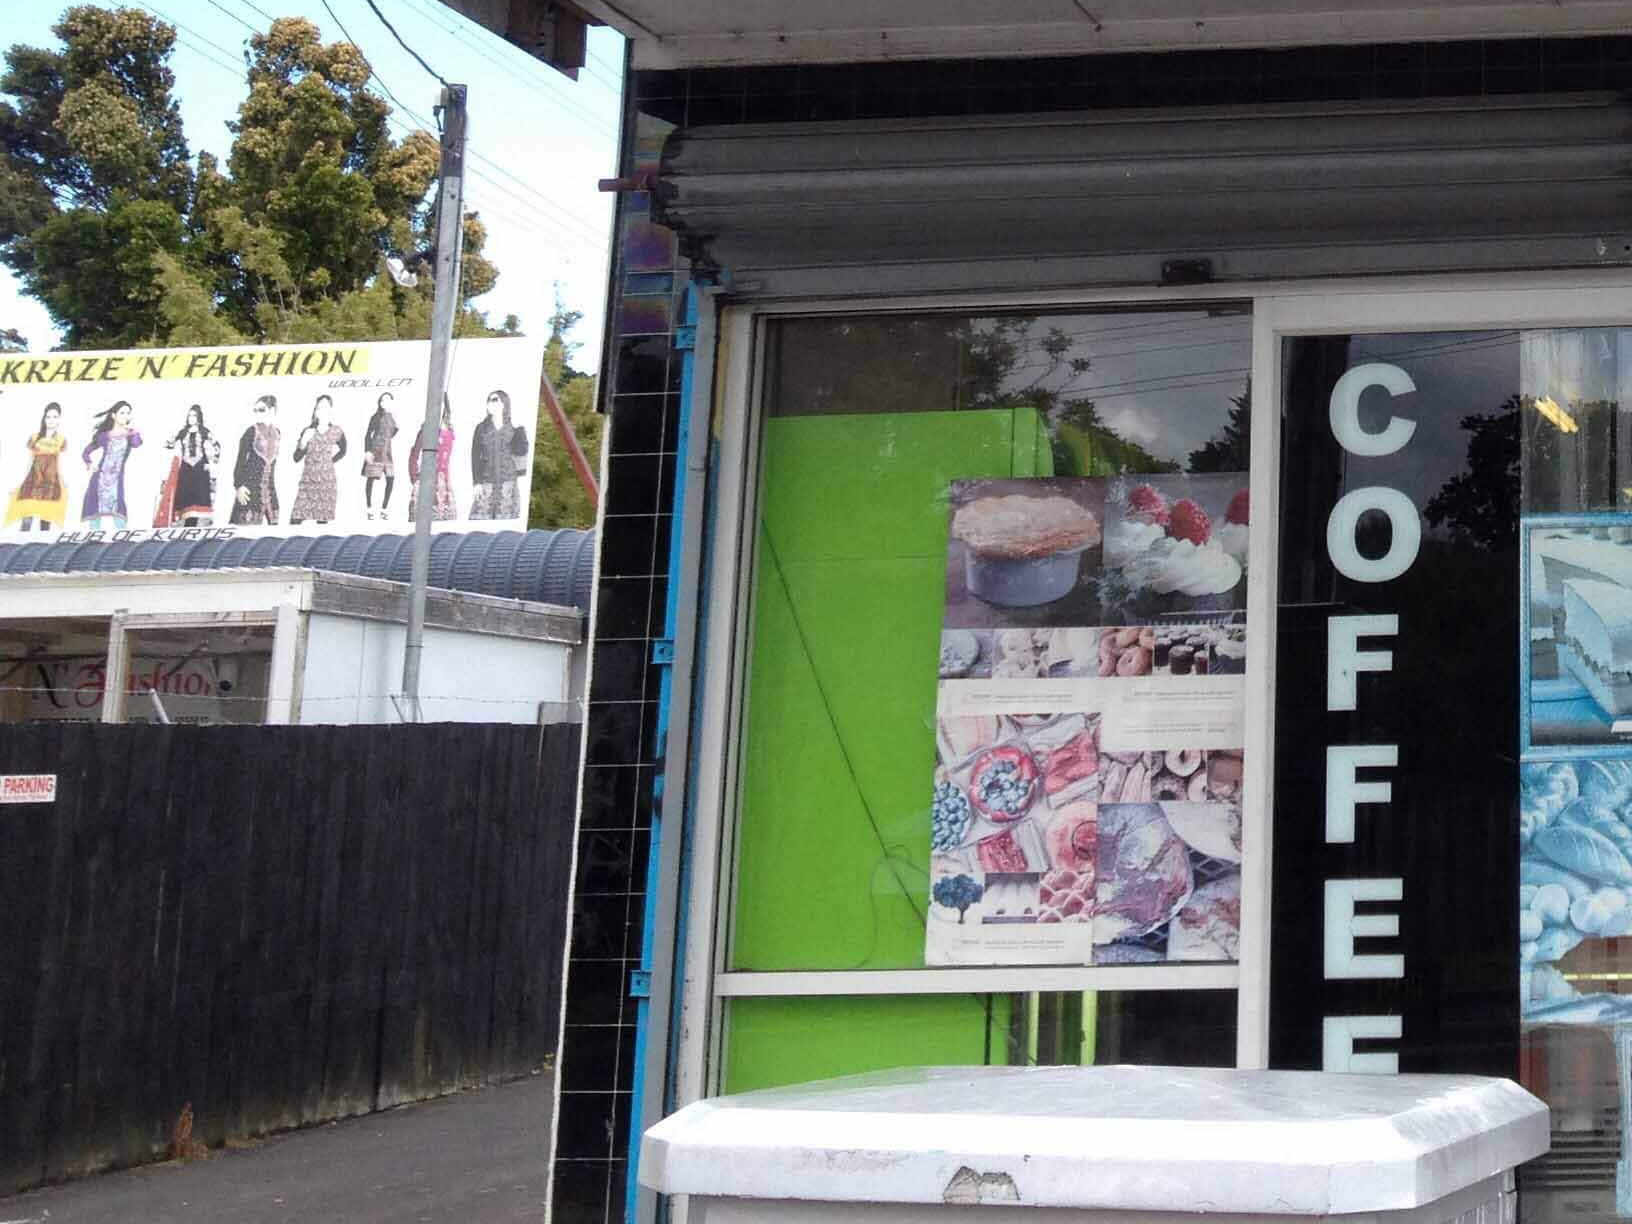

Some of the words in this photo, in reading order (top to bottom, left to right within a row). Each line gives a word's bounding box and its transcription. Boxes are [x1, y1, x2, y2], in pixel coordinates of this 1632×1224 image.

[1, 357, 124, 384] KRAZE
[185, 350, 357, 377] FASHION
[3, 776, 53, 792] PARKING
